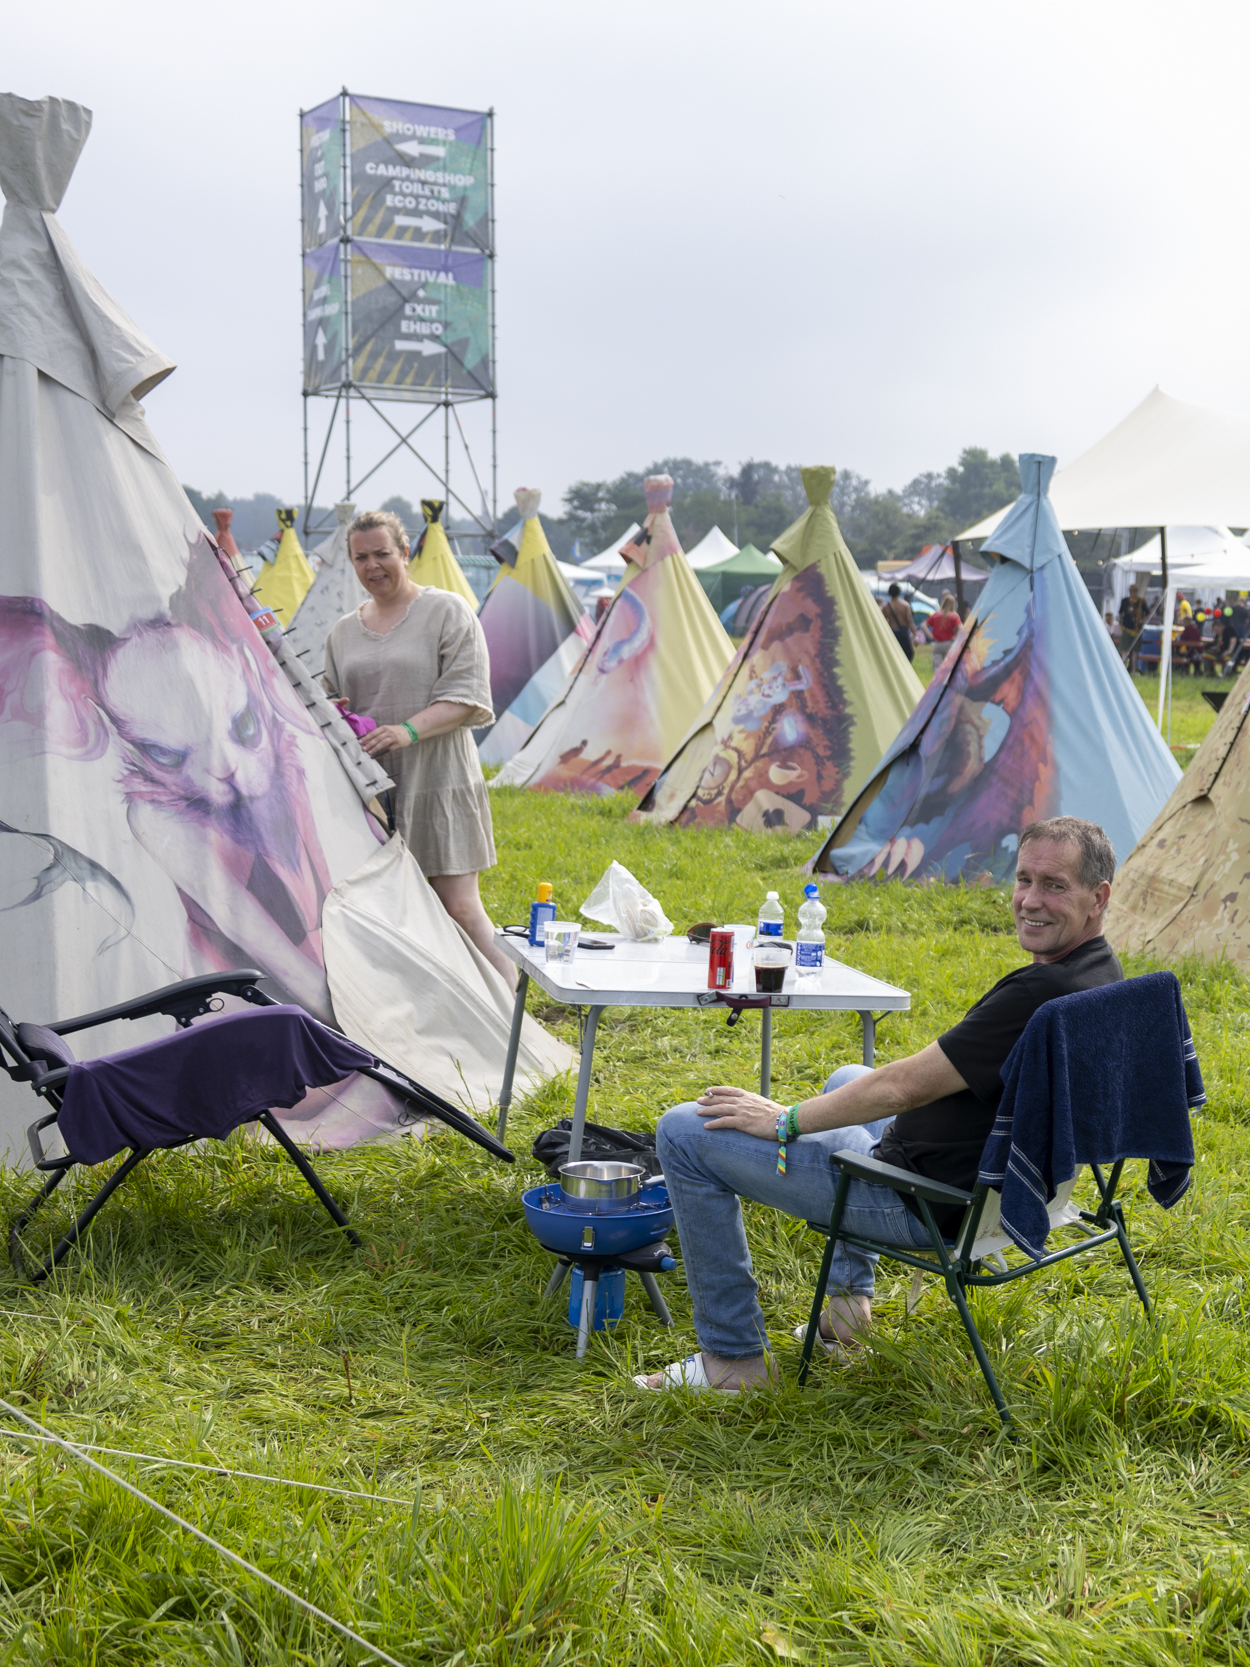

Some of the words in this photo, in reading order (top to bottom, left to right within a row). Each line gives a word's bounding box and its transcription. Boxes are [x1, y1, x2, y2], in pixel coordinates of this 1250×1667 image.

[383, 120, 456, 140] SHOWERS
[365, 162, 475, 186] CAMPINGSHOP
[392, 179, 450, 200] TOILETS
[386, 193, 417, 209] ECO
[418, 197, 457, 215] ZONE
[385, 265, 457, 285] FESTIVAL
[404, 302, 439, 317] EXIT
[401, 319, 444, 335] EHBO
[258, 615, 270, 626] 11
